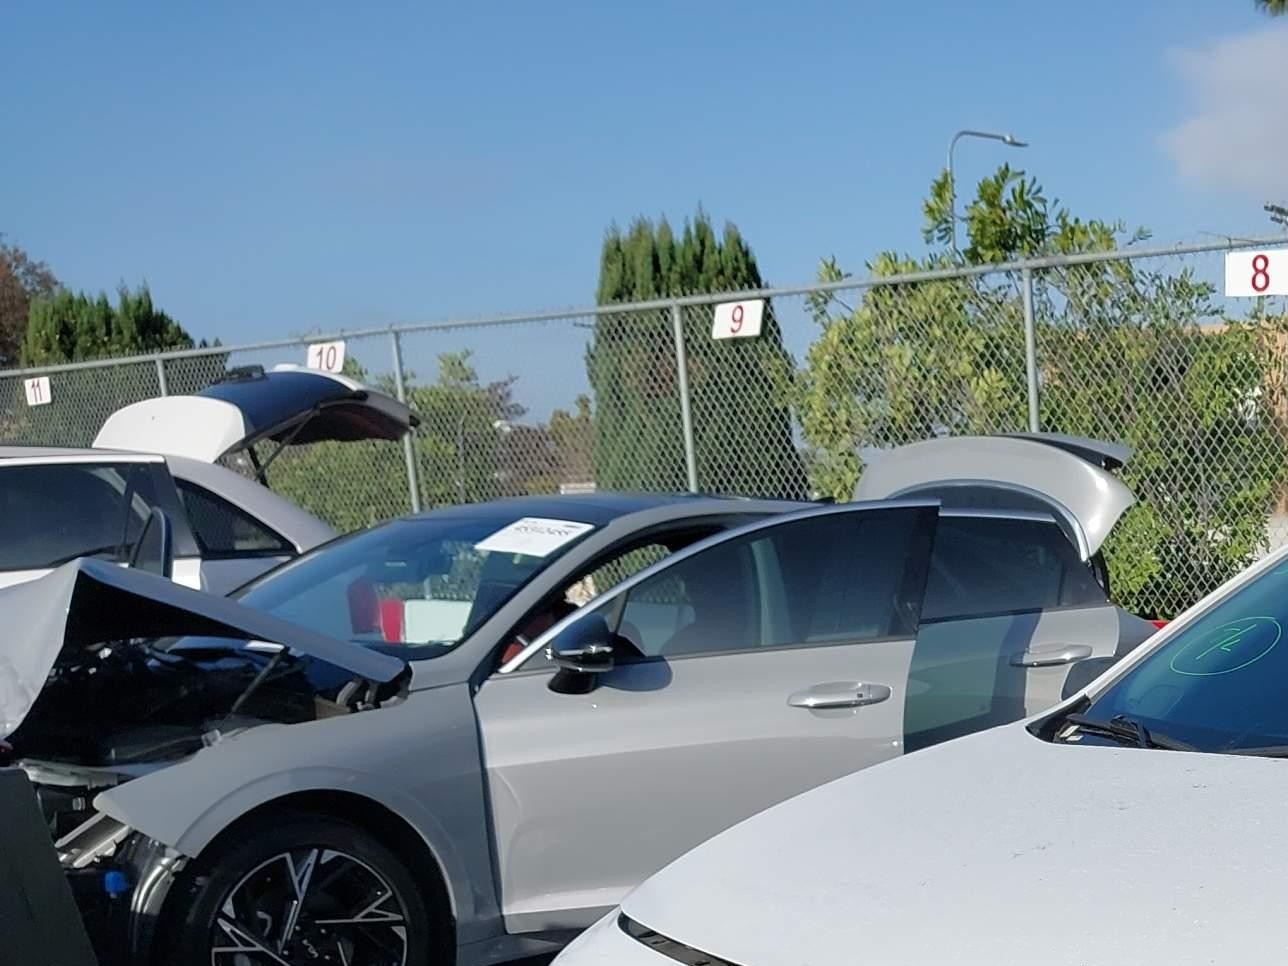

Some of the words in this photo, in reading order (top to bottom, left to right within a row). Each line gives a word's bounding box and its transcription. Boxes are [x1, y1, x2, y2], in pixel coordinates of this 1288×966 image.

[1250, 254, 1270, 293] 8
[729, 305, 744, 333] 9
[315, 345, 337, 370] 10
[30, 378, 43, 404] 11
